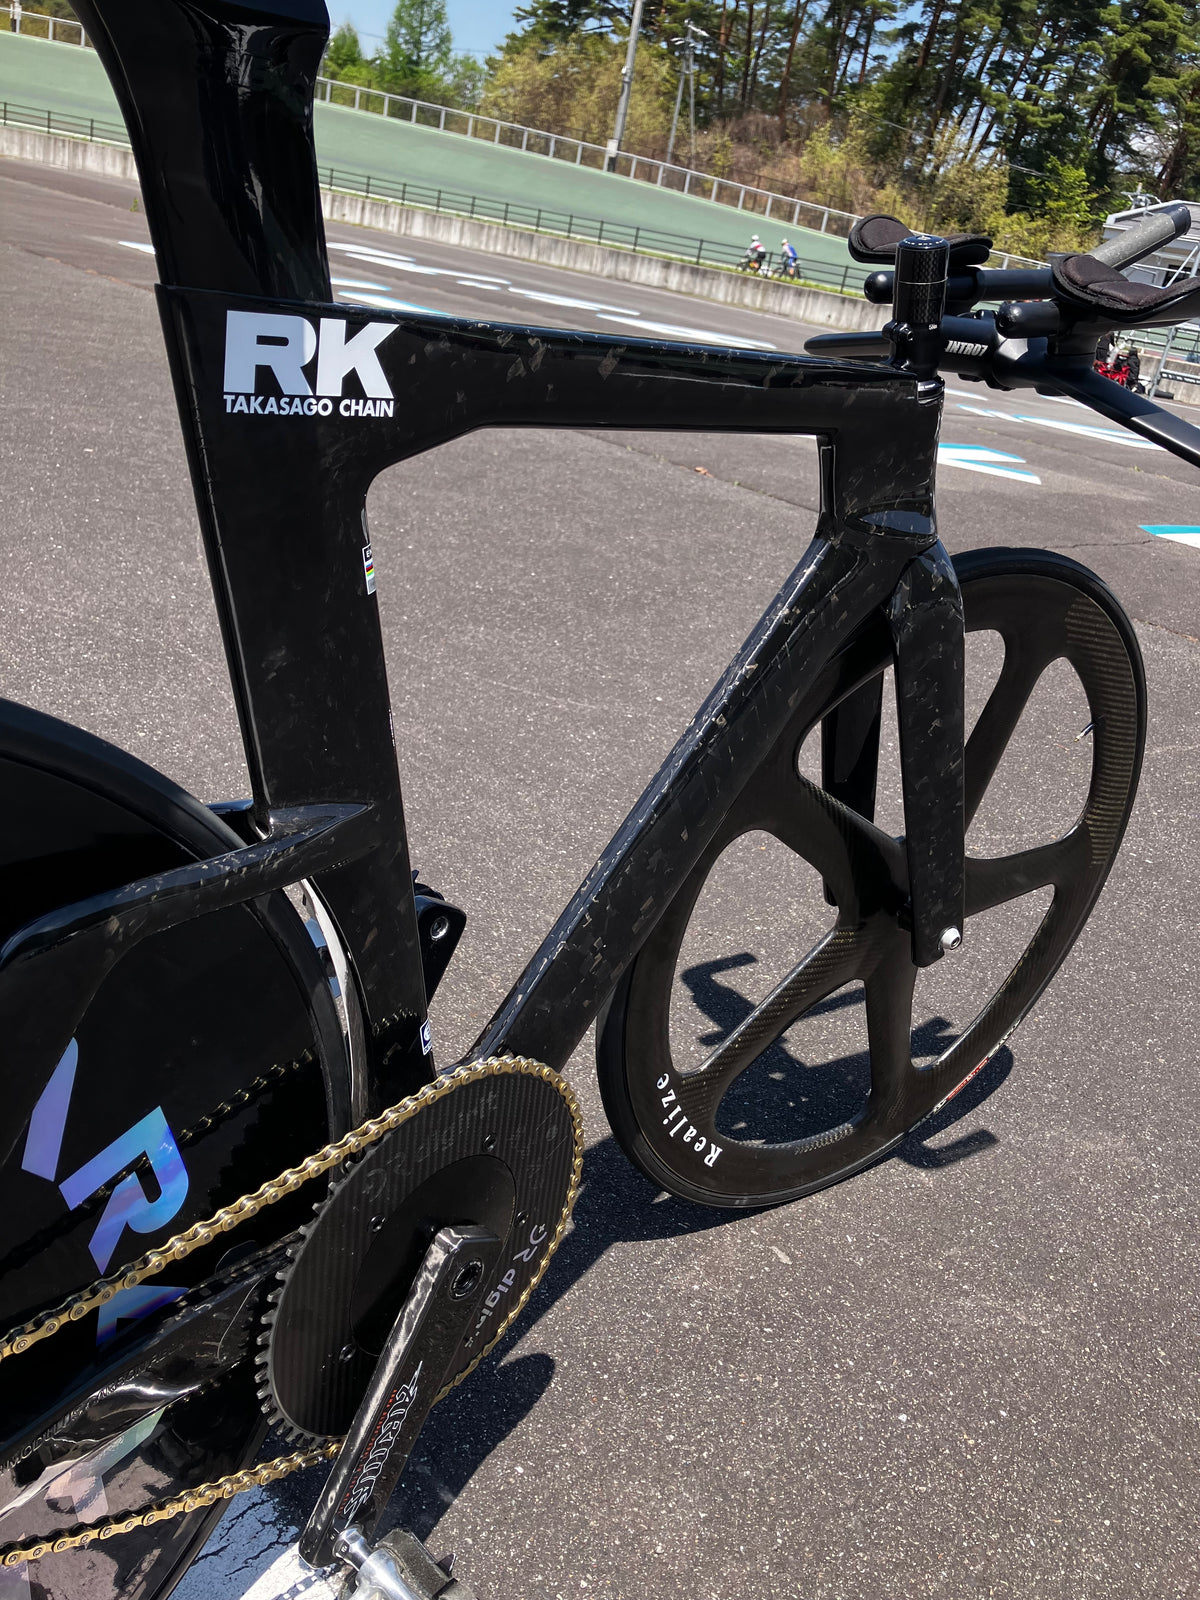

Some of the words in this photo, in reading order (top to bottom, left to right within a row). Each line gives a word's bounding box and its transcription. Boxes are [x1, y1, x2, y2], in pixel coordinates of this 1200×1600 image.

[223, 309, 400, 399] RK
[223, 394, 333, 416] TAKASAGO
[339, 398, 395, 418] CHAIN
[657, 1073, 723, 1168] Realize
